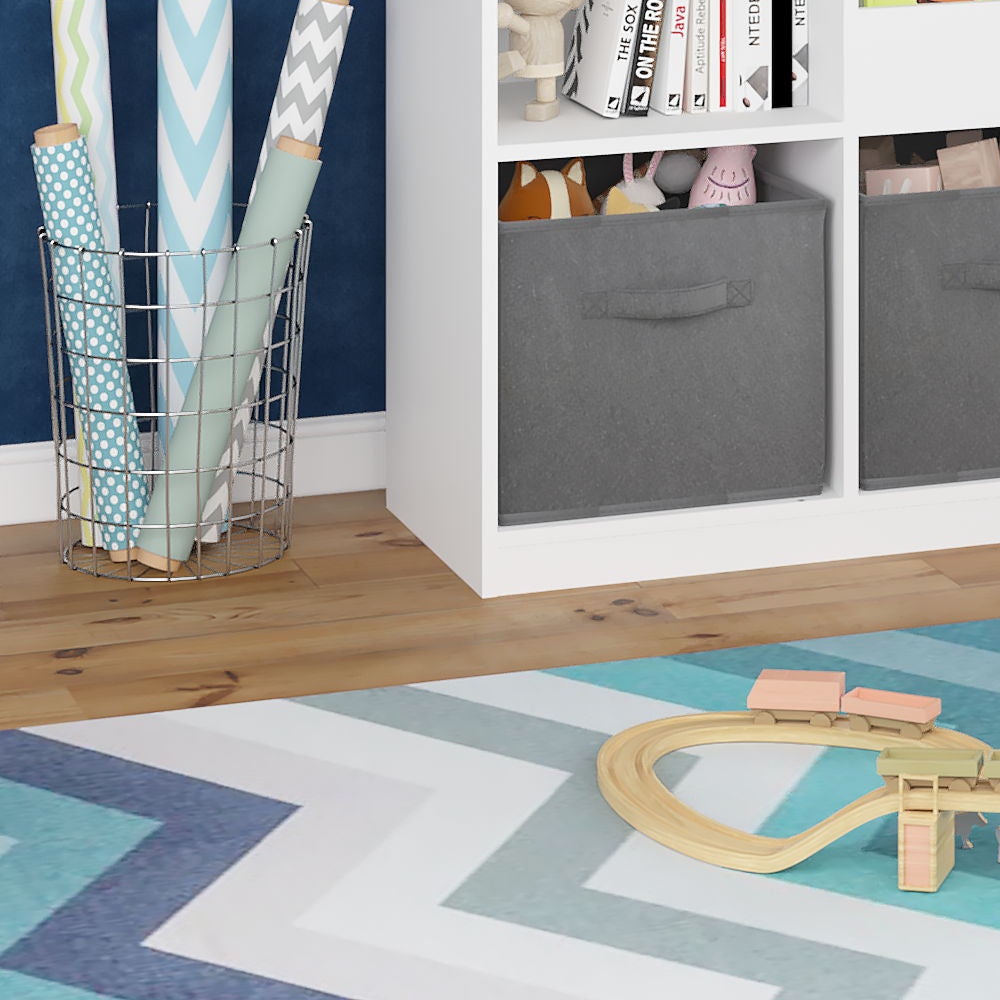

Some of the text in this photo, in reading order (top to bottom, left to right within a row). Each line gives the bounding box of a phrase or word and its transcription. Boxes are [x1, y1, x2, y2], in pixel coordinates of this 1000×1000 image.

[617, 4, 638, 61] THE SOX
[639, 23, 660, 53] THE
[670, 5, 686, 38] Java
[695, 27, 706, 74] Aptitude
[635, 55, 656, 80] ON
